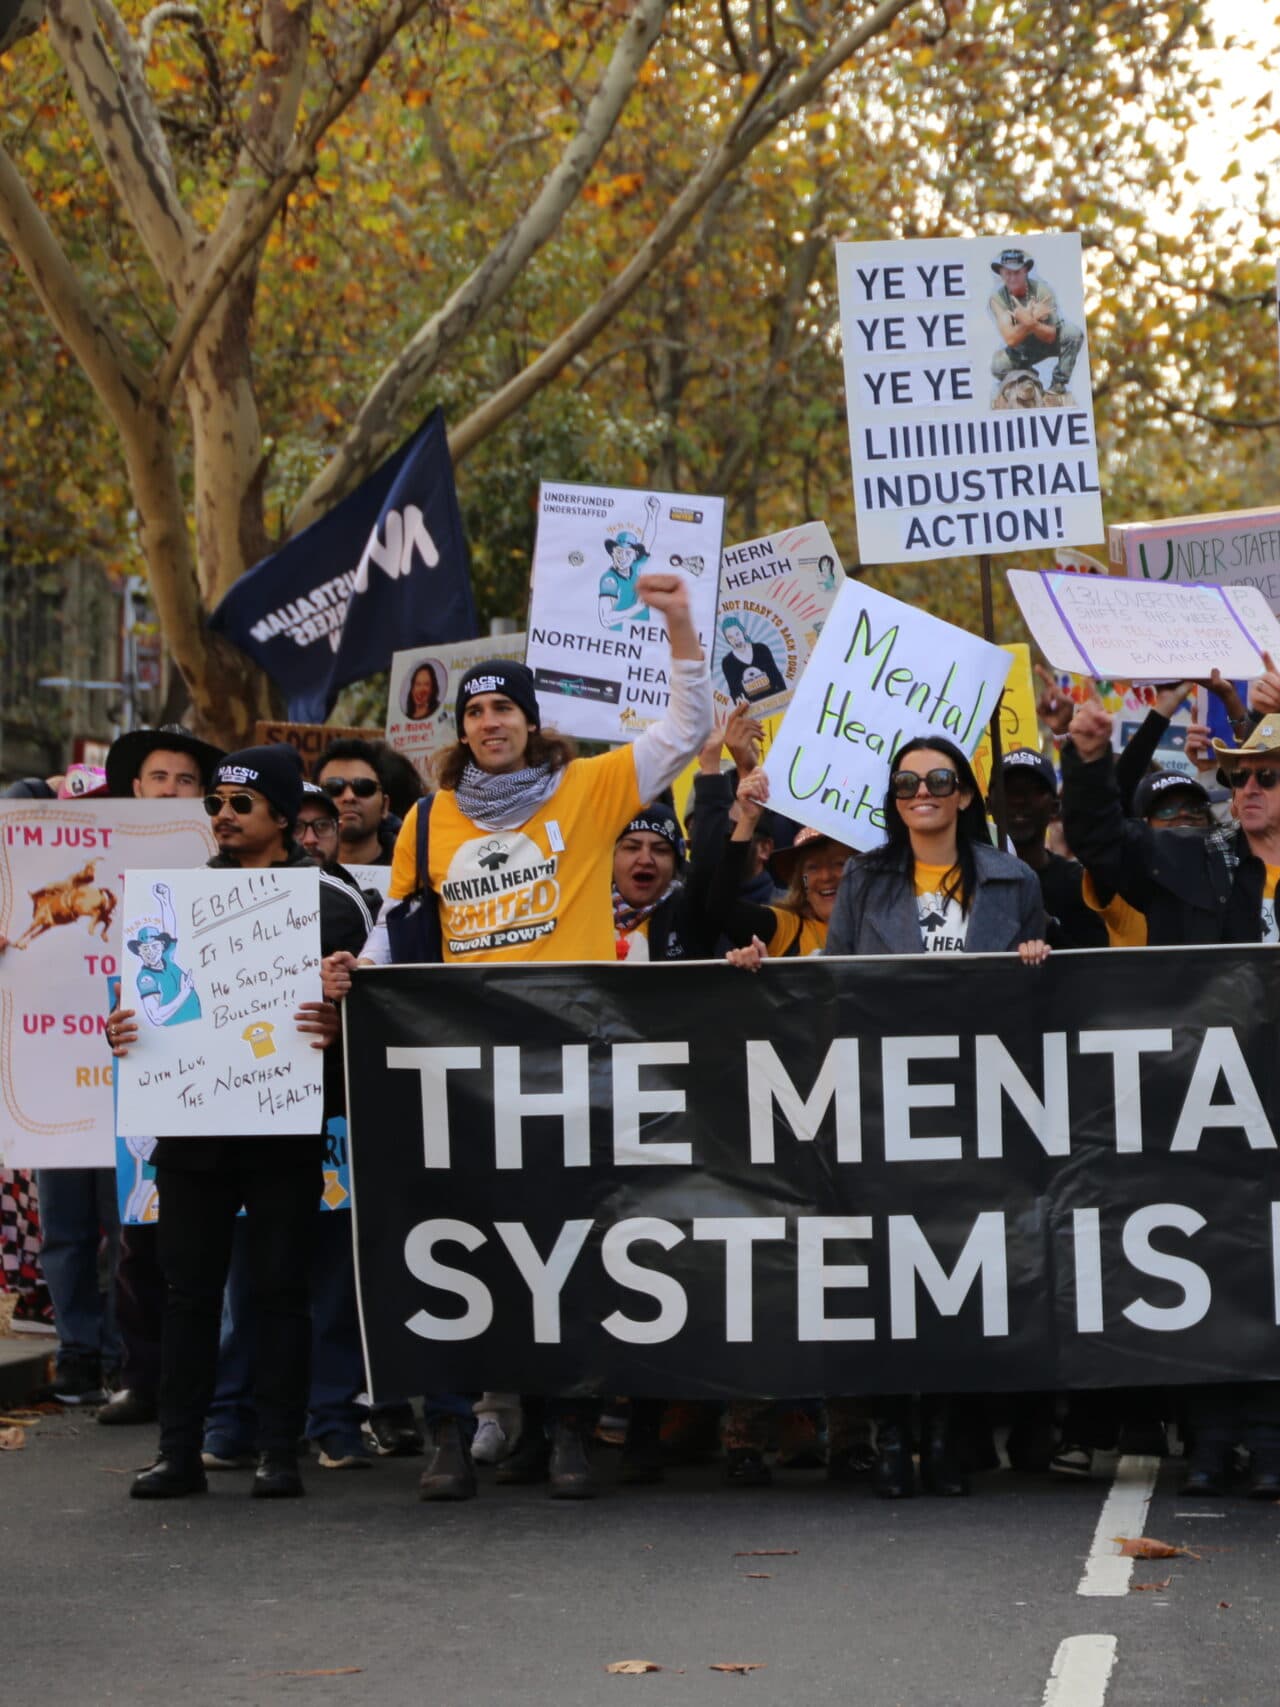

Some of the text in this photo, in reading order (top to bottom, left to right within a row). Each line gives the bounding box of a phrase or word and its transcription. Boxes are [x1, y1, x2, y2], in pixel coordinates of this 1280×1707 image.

[857, 264, 965, 300] YE YE
[857, 314, 966, 351] YE YE
[864, 367, 972, 405] YE YE
[544, 492, 614, 508] UNDERFUNDED
[864, 461, 1099, 509] INDUSTRIAL
[543, 504, 607, 518] UNDERSTAFFED
[905, 507, 1065, 549] ACTION!
[725, 541, 773, 567] HERN
[1139, 540, 1225, 581] UNDER
[726, 558, 792, 590] HEALTH
[722, 600, 739, 612] NOT
[743, 600, 773, 618] READY
[771, 615, 783, 628] TO
[531, 628, 642, 660] NORTHERN
[629, 625, 707, 648] MENL
[464, 676, 505, 692] HACSU
[628, 666, 667, 684] HEA
[844, 608, 986, 744] Mental
[626, 687, 671, 706] UNIT
[817, 682, 902, 764] Heal
[218, 765, 260, 781] HACSU
[1003, 751, 1041, 764] HACSU
[1158, 759, 1189, 770] ector
[789, 746, 887, 830] Unite
[6, 826, 112, 848] I'M JUST
[442, 860, 556, 902] MENTAL HEALTH
[191, 873, 279, 926] EBA!!!
[448, 879, 559, 934] UNITED
[199, 942, 217, 968] IT
[229, 936, 243, 954] IS
[252, 920, 281, 942] ALL
[449, 921, 555, 953] UNION POWER
[84, 955, 117, 976] TO
[23, 1014, 108, 1036] UP SO
[76, 1066, 113, 1087] RIG
[138, 1071, 171, 1087] WITH
[177, 1062, 292, 1109] THE NORTHERN
[257, 1084, 322, 1115] HEALTH
[386, 1041, 692, 1170] THE
[403, 1210, 1009, 1345] SYSTEM
[1073, 1203, 1212, 1334] IS
